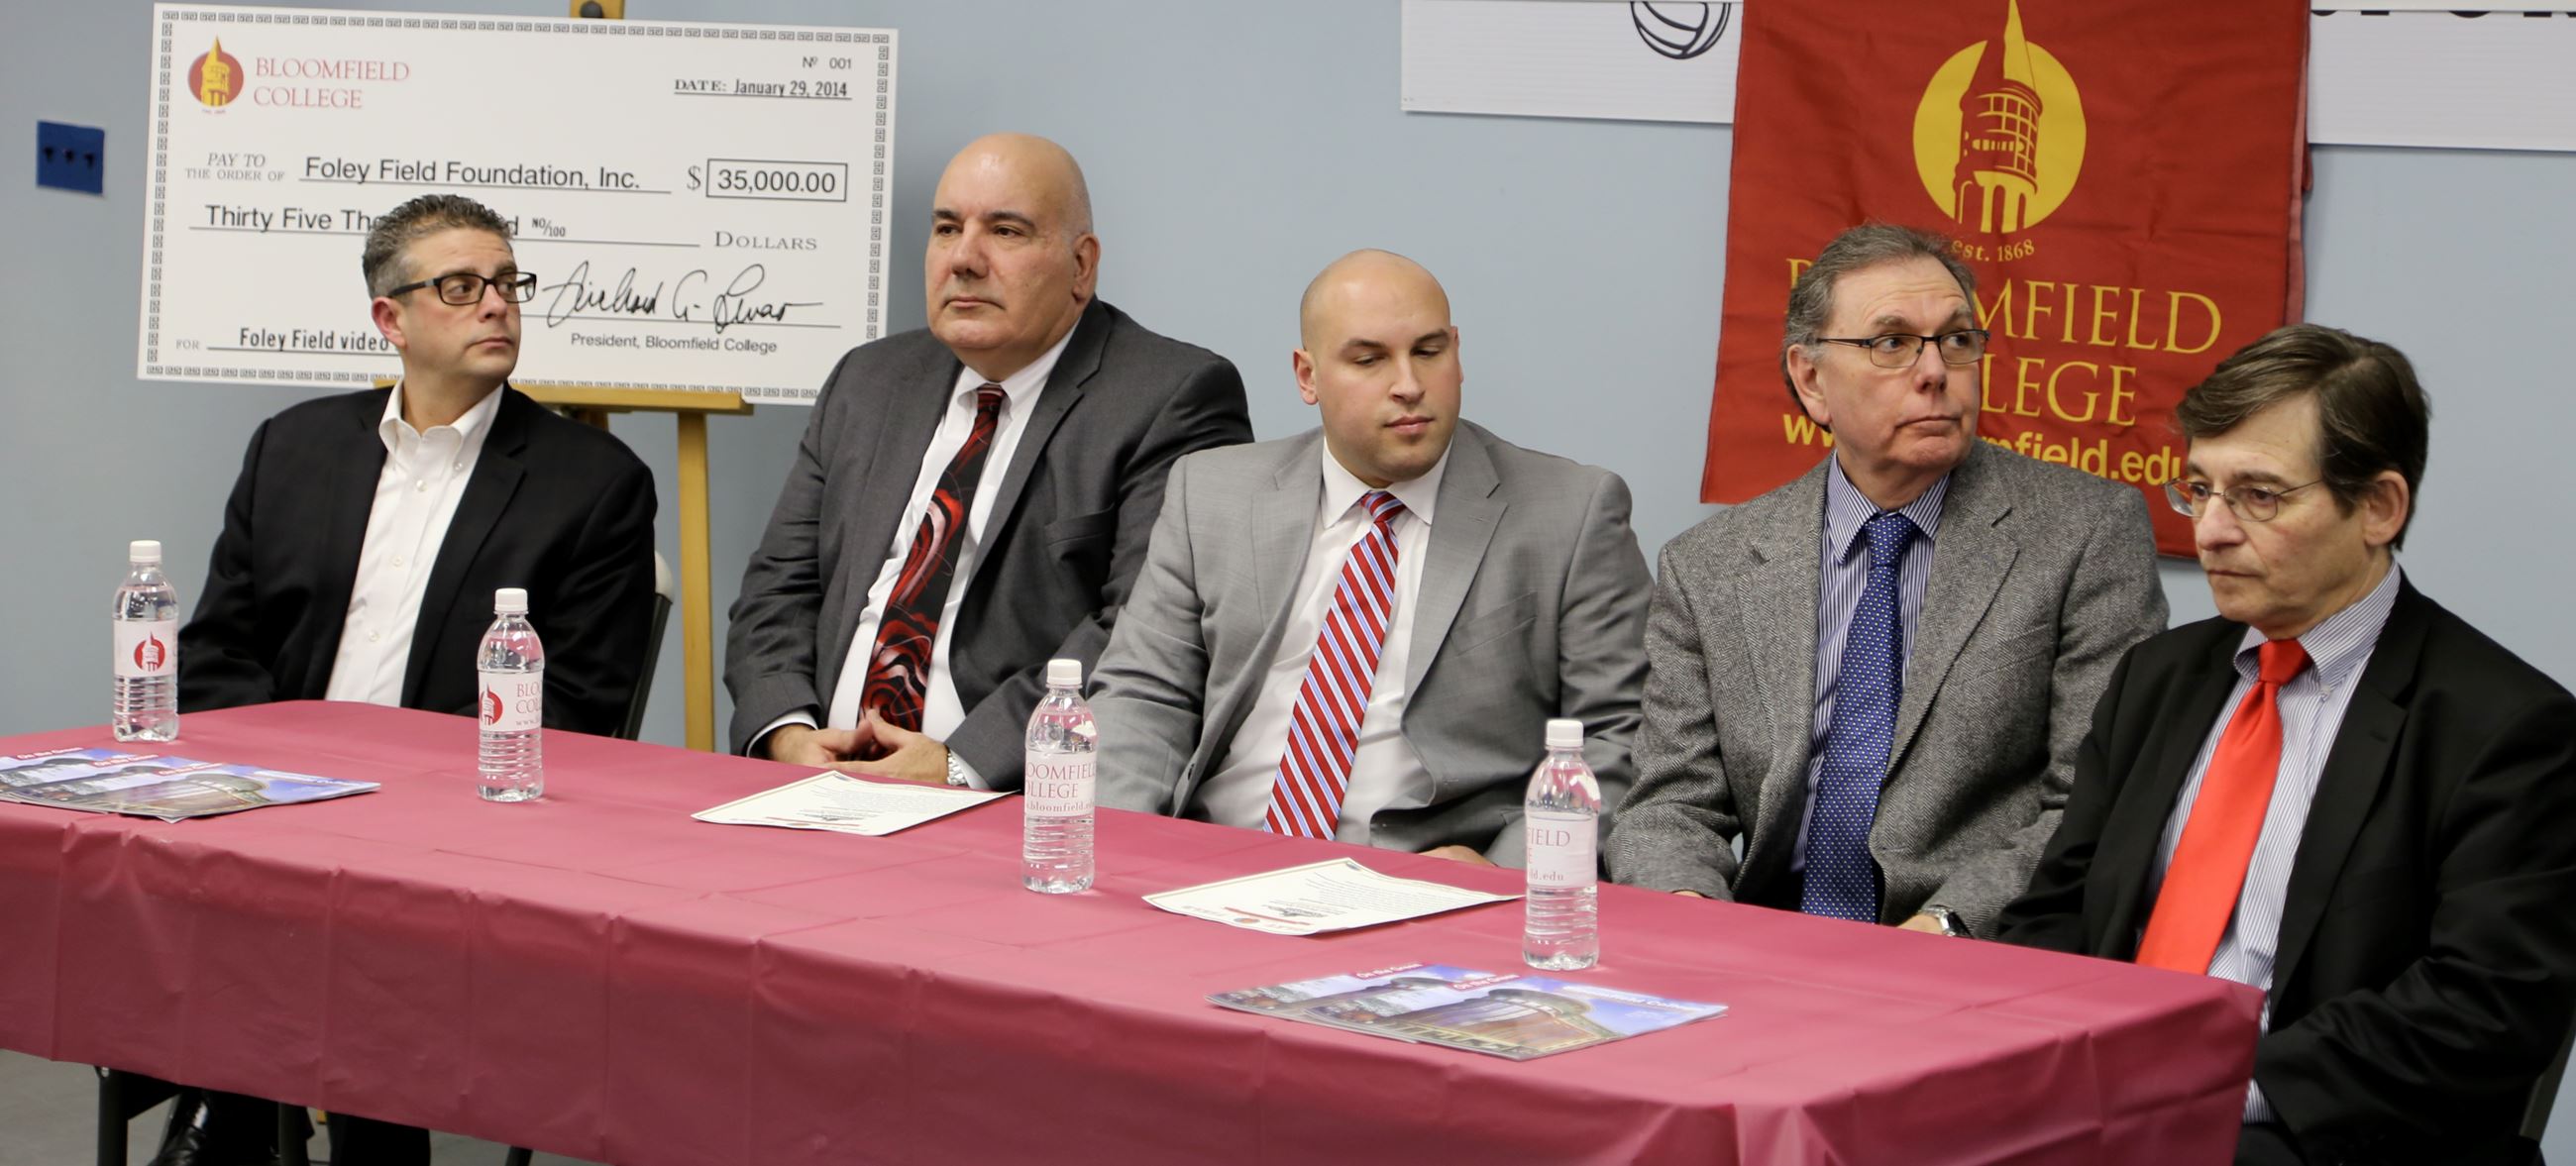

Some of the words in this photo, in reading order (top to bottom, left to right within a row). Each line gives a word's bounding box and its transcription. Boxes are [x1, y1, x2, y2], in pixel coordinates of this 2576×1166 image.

[255, 56, 410, 82] BLOOMFIELD
[829, 57, 852, 69] 001
[253, 86, 363, 109] COLLEGE
[674, 78, 727, 92] DATE:
[734, 78, 786, 97] January
[790, 79, 810, 98] 29,
[814, 81, 848, 97] 2014
[207, 153, 238, 166] PAY
[244, 154, 266, 167] TO
[185, 168, 211, 180] THE
[217, 169, 262, 181] ORDER
[268, 170, 285, 181] OF
[305, 157, 371, 185] Foley
[378, 159, 437, 182] Field
[446, 161, 590, 190] Foundation,
[598, 166, 641, 189] Inc.
[687, 164, 702, 191] $
[716, 167, 836, 194] 35,000.00
[205, 204, 273, 233] Thirty
[282, 206, 332, 230] Five
[1950, 239, 1990, 262] est.
[1996, 238, 2035, 263] 1868
[175, 339, 200, 351] FOR
[239, 327, 286, 353] Foley
[291, 329, 335, 352] Field
[340, 331, 389, 353] video
[571, 332, 641, 349] President,
[645, 334, 720, 352] Bloomfield
[723, 338, 779, 355] College
[1981, 353, 2137, 427] LEGE
